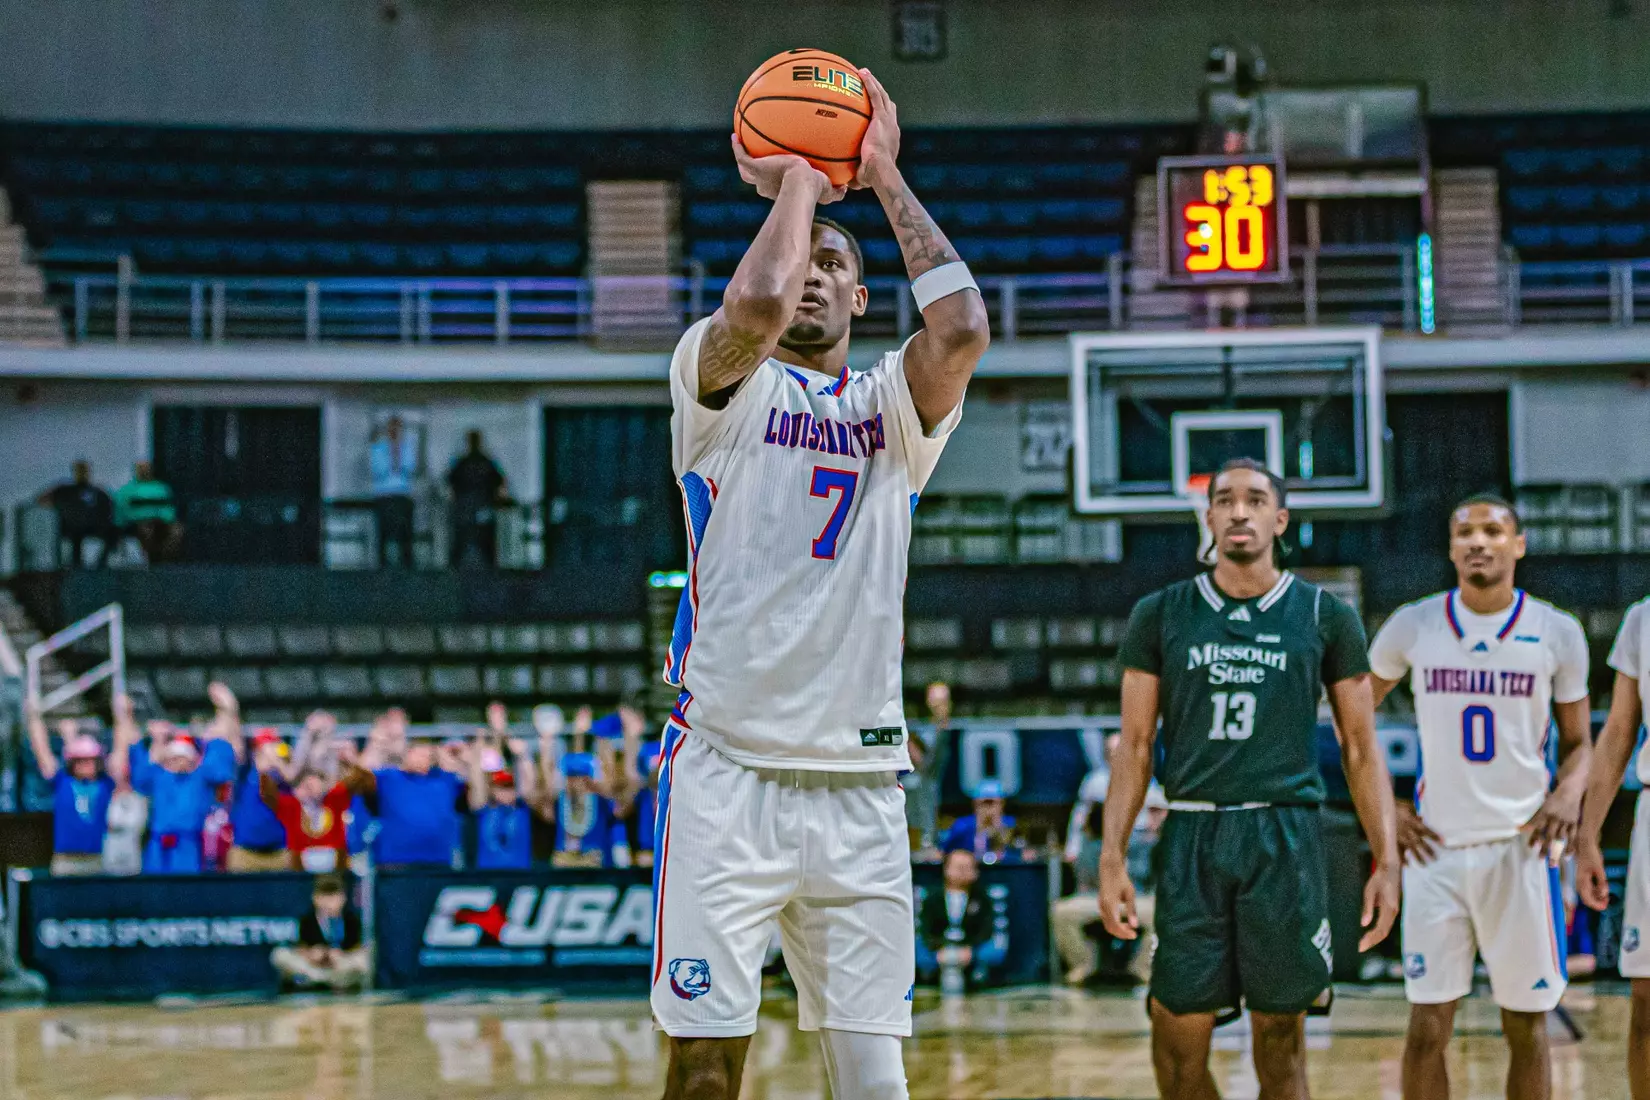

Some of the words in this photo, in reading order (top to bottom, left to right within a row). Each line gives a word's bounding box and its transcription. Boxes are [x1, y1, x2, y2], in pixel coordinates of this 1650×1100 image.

[792, 66, 863, 97] ELITE
[1204, 165, 1272, 206] 1:53
[1184, 205, 1263, 270] 30
[852, 412, 886, 459] TEH
[809, 465, 859, 560] 7
[1187, 641, 1288, 672] Missouri
[1207, 661, 1266, 685] State
[1423, 667, 1496, 696] LOUISIANA
[1499, 671, 1536, 698] TECH
[1207, 690, 1258, 741] 13
[1461, 703, 1496, 765] 0
[210, 915, 300, 945] NETW
